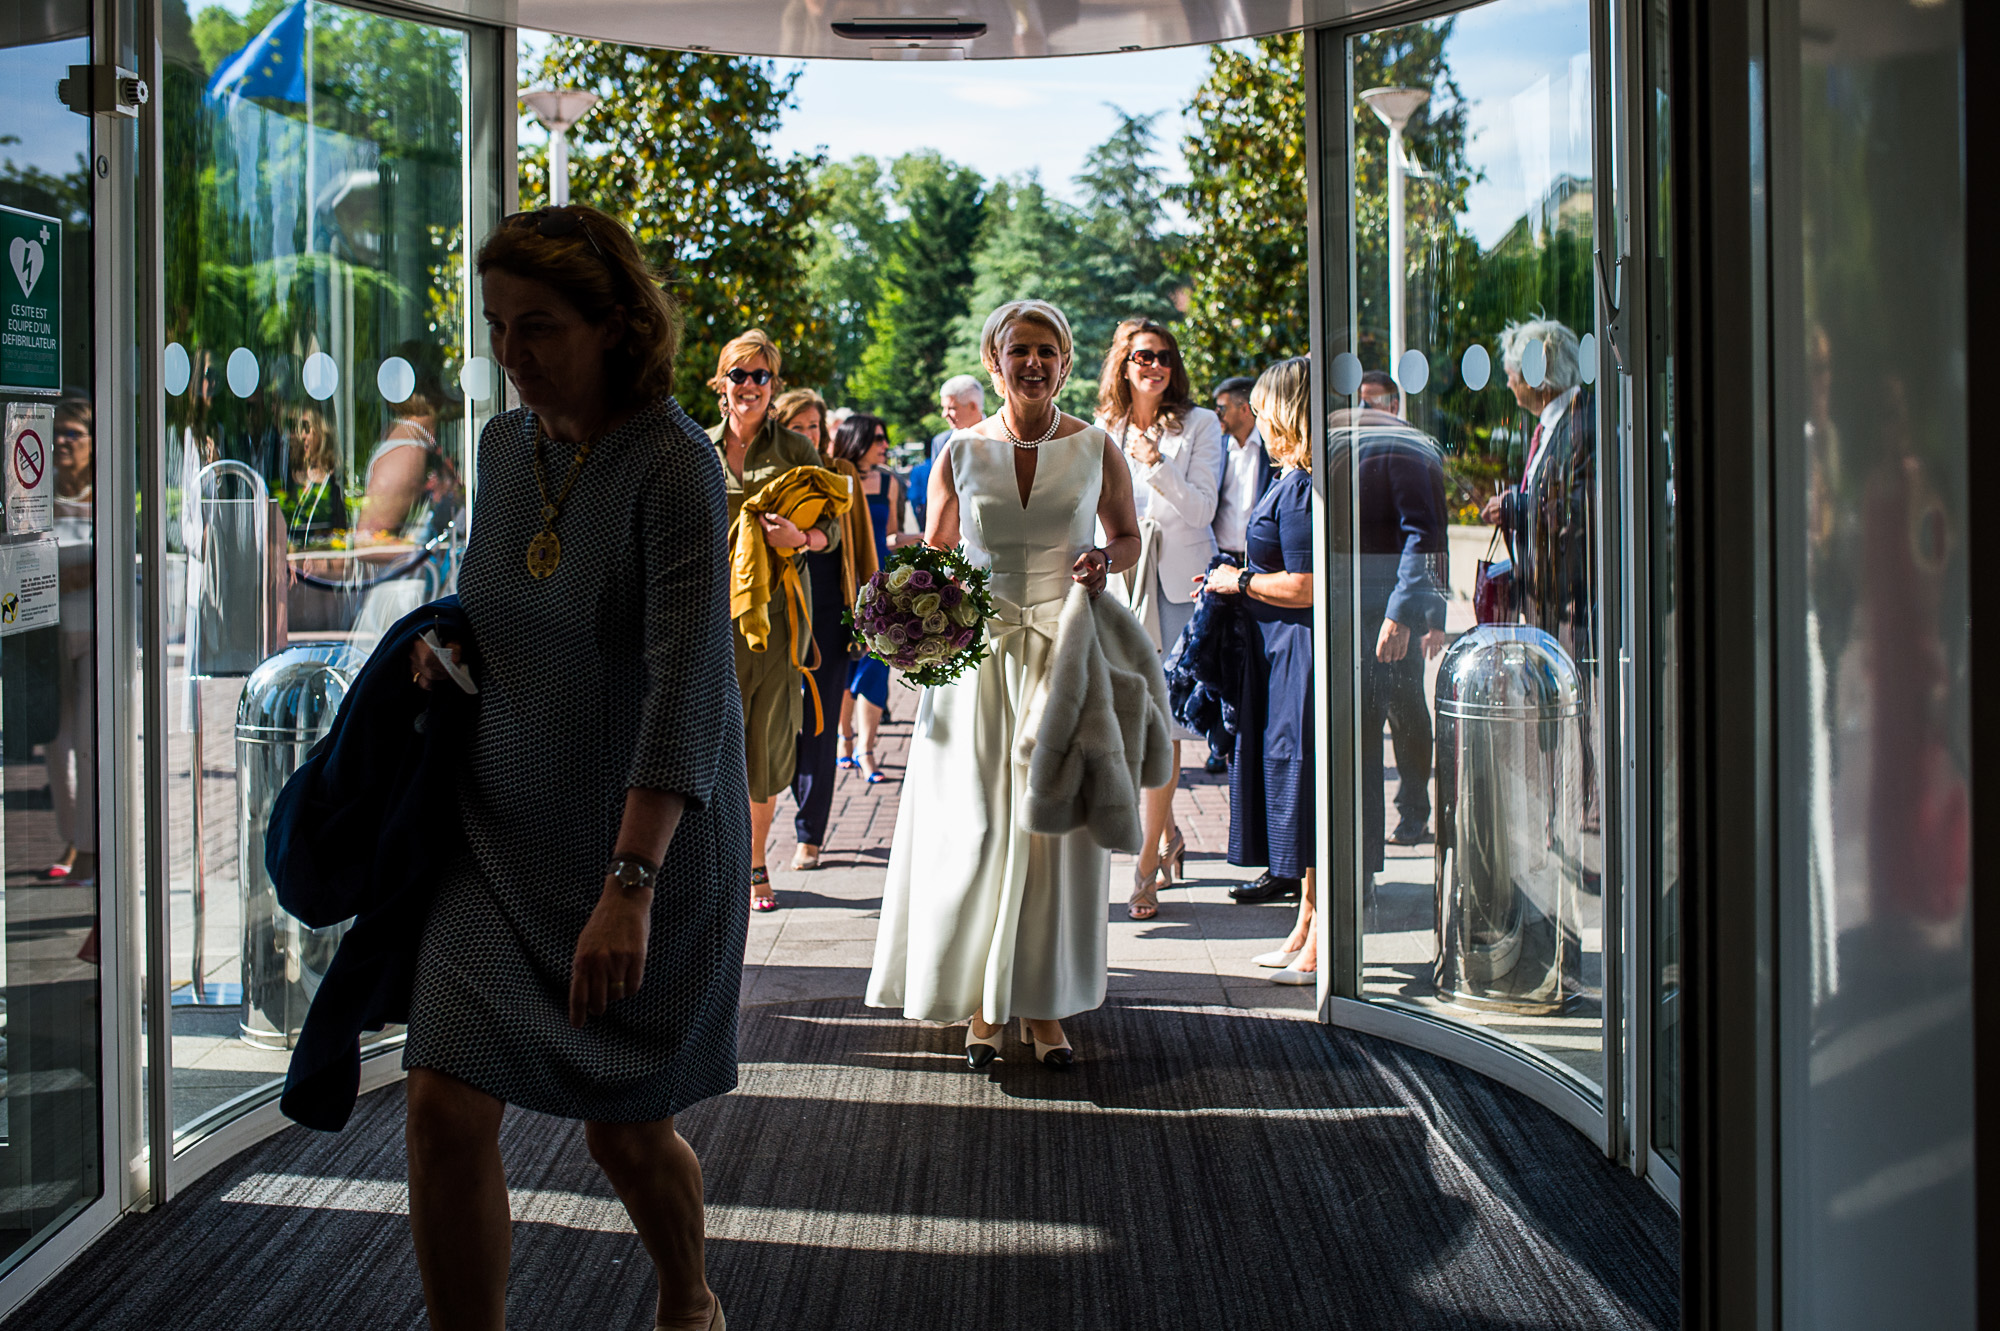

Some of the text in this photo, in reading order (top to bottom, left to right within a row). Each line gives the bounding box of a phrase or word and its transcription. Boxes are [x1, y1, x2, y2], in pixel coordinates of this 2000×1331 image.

[12, 304, 47, 319] CE SITE EST
[8, 318, 51, 334] EQUIPE D'UN
[2, 333, 56, 350] DEFIBRILLATEUR
